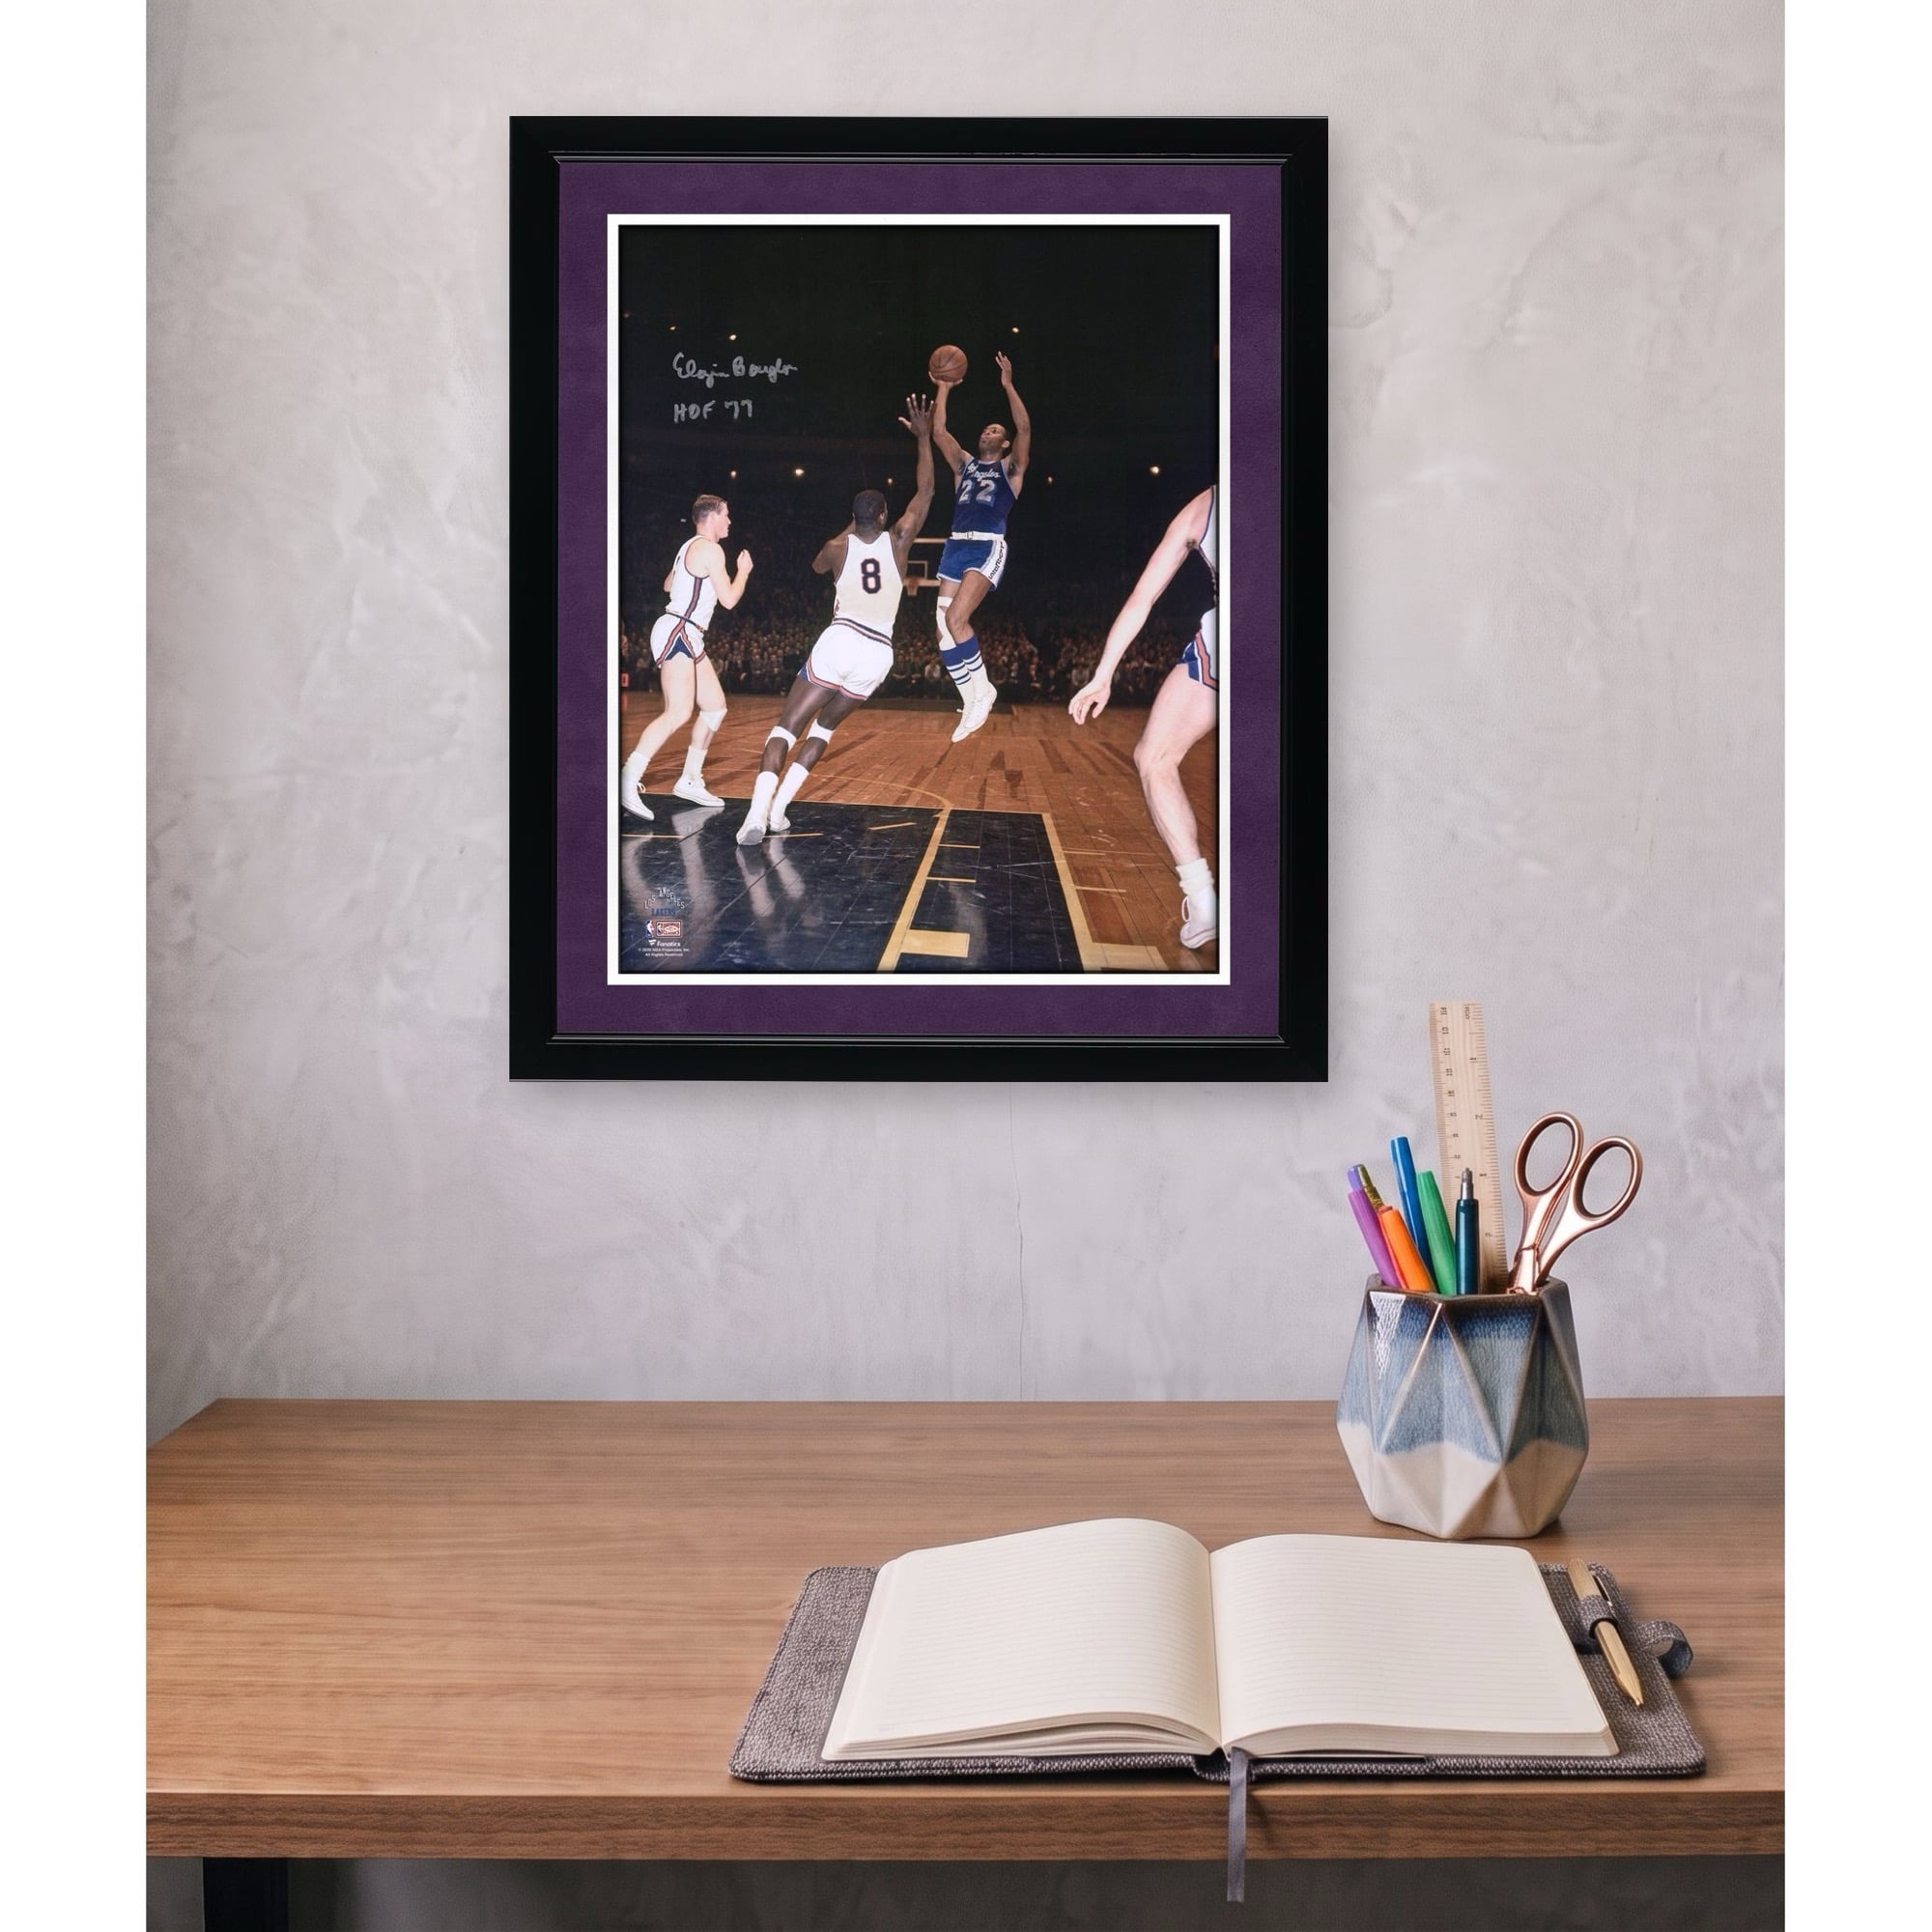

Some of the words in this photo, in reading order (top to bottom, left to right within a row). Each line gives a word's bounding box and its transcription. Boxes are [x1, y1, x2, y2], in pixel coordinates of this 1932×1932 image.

[673, 400, 716, 423] HOF
[958, 479, 996, 505] 22
[861, 557, 881, 594] 8
